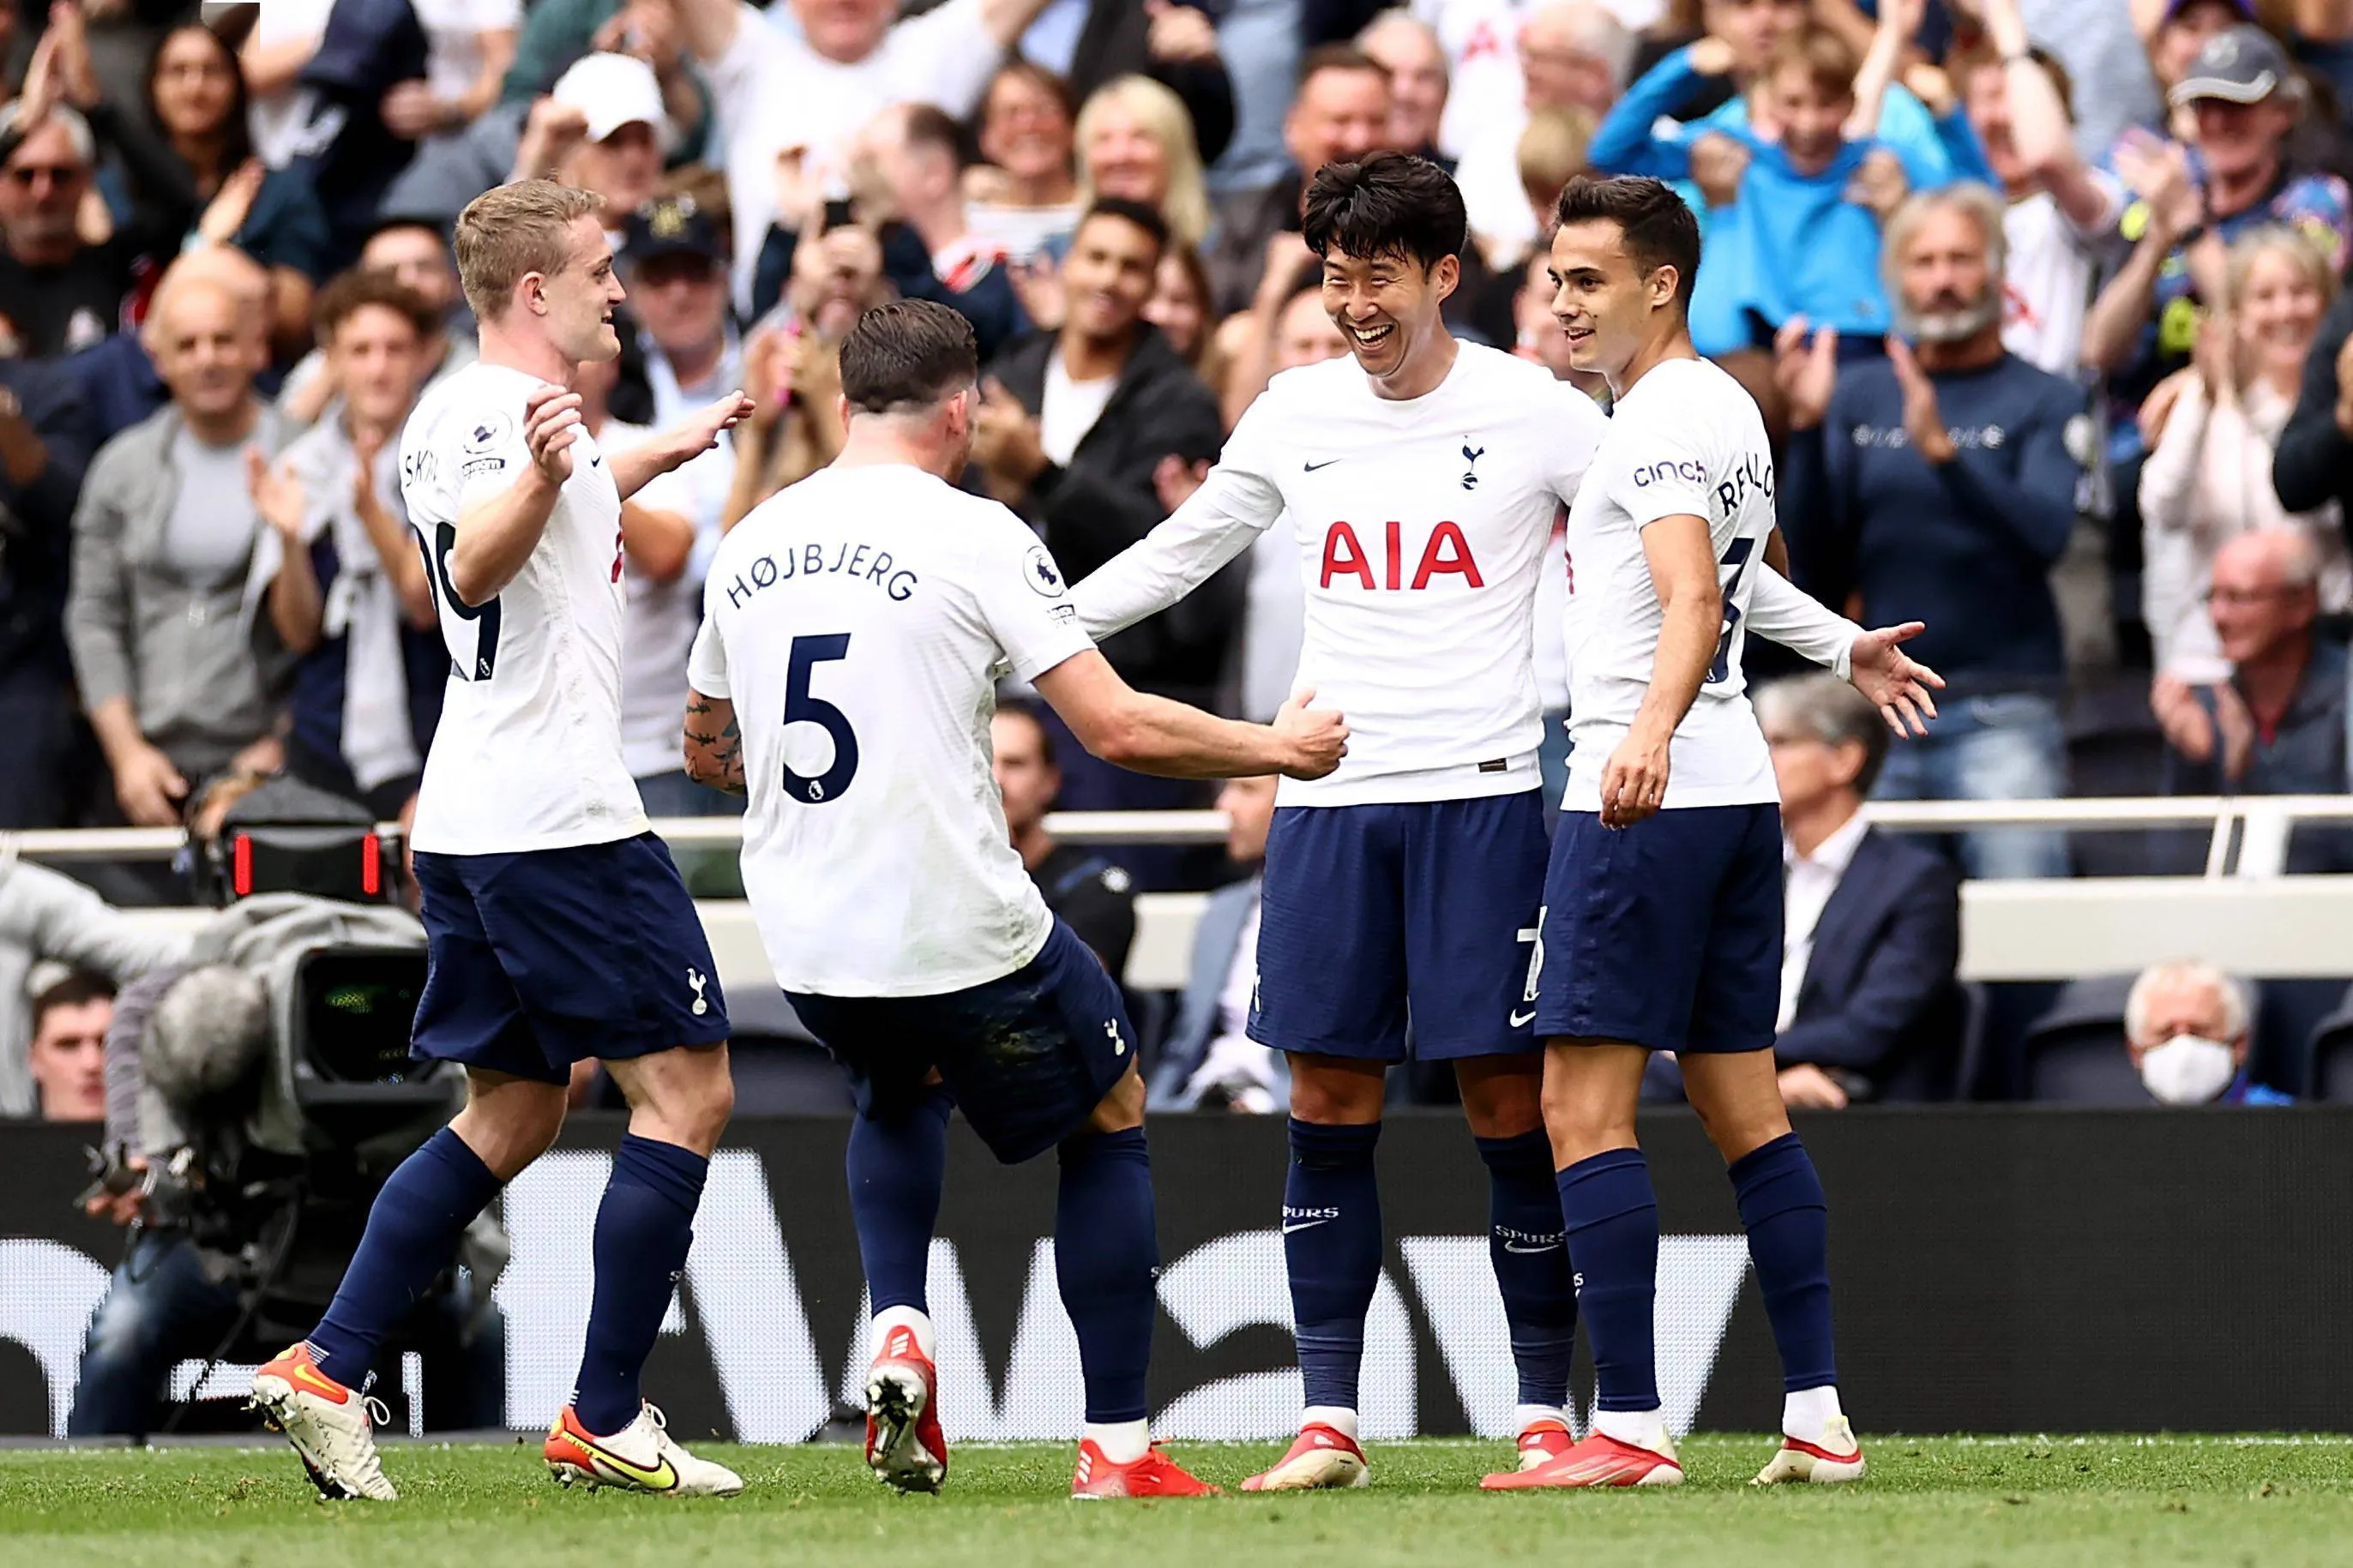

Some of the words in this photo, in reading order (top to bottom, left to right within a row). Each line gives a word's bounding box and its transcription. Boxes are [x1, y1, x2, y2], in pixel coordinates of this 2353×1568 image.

[1634, 460, 1707, 488] cinch
[726, 542, 918, 610] HØJBJERG
[1319, 520, 1486, 591] AIA
[782, 632, 858, 804] 5
